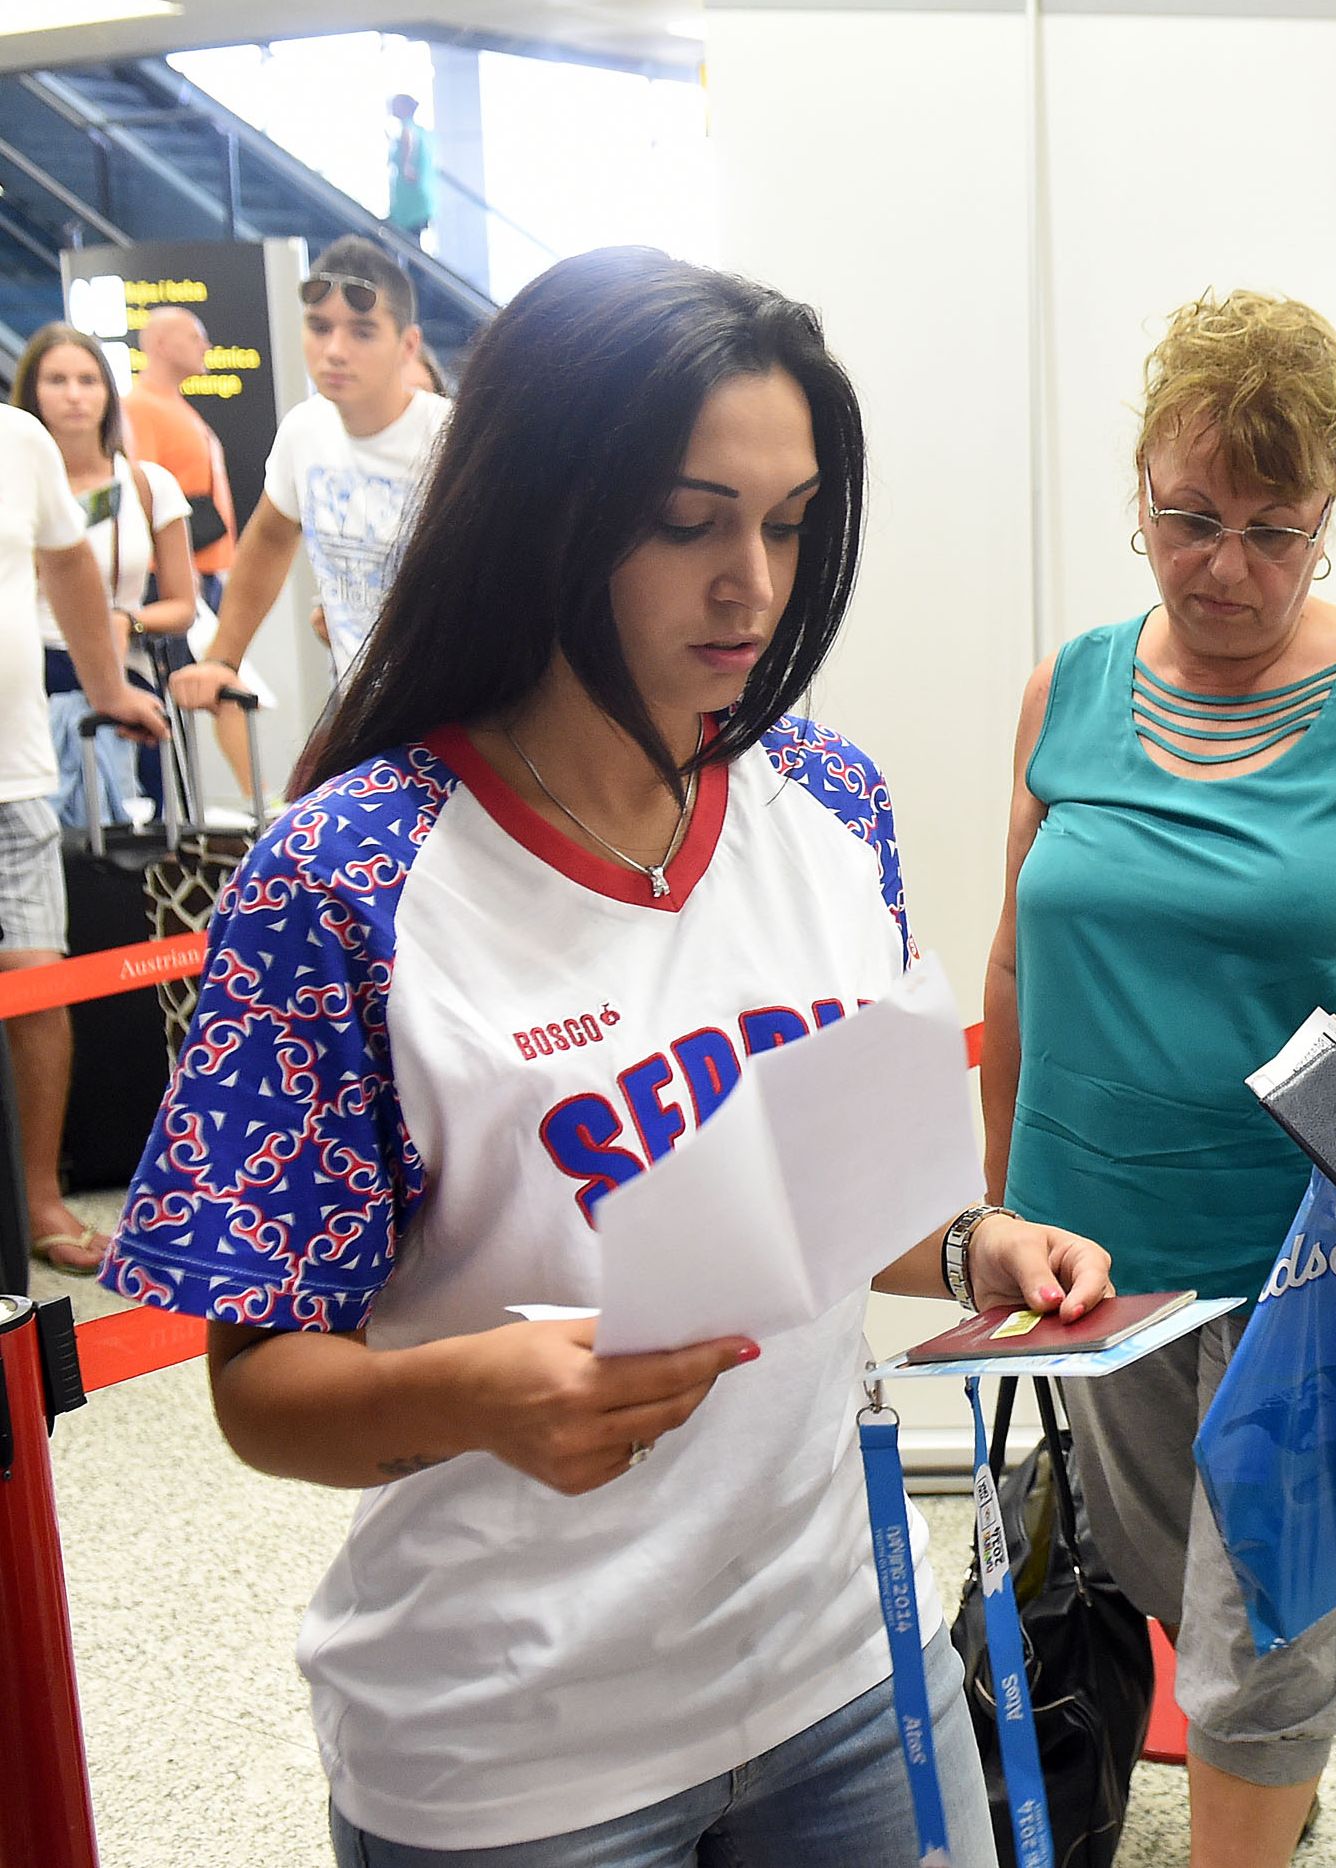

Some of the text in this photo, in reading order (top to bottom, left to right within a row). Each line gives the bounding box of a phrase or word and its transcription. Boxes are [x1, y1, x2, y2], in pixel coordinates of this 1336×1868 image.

[119, 948, 199, 980] Austrian
[513, 1014, 603, 1061] BOSCO
[892, 1583, 913, 1634] 2014
[1001, 1673, 1024, 1722] Atos
[902, 1714, 927, 1765] Atos
[1017, 1798, 1038, 1851] 2014
